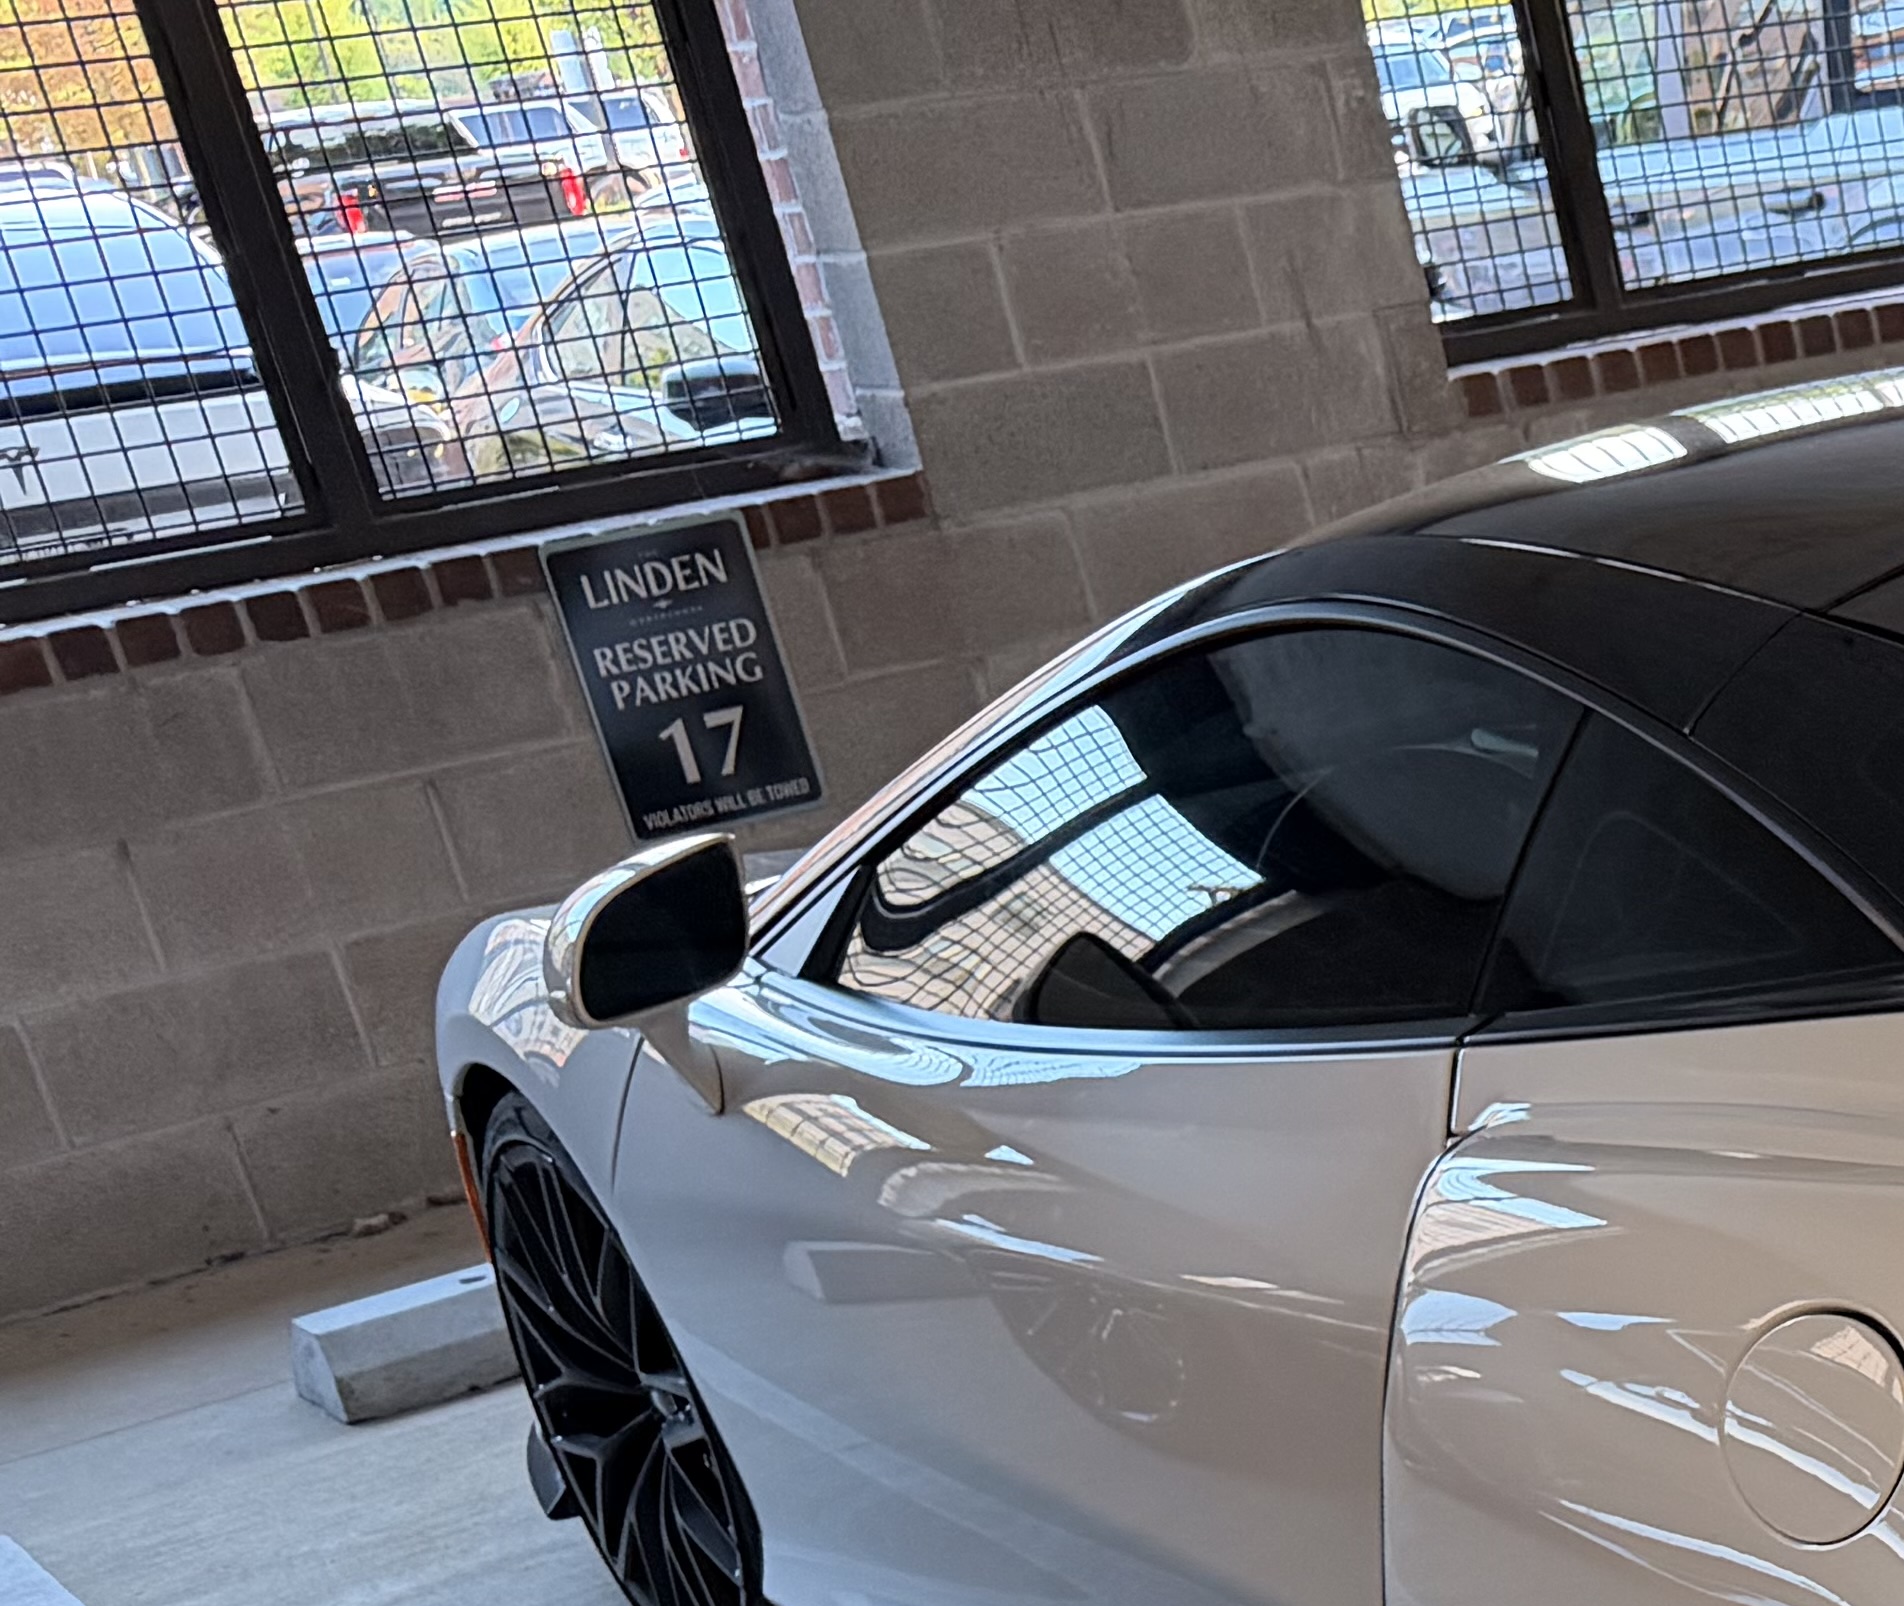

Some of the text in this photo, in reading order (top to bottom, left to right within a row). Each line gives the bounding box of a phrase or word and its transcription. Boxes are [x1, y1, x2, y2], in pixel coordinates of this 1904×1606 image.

[580, 548, 728, 609] LINDEN
[593, 617, 757, 678] RESERVED
[610, 652, 763, 710] PARKING
[659, 705, 745, 784] 17
[643, 777, 811, 831] VIOLATORS WILL BE TOWED
